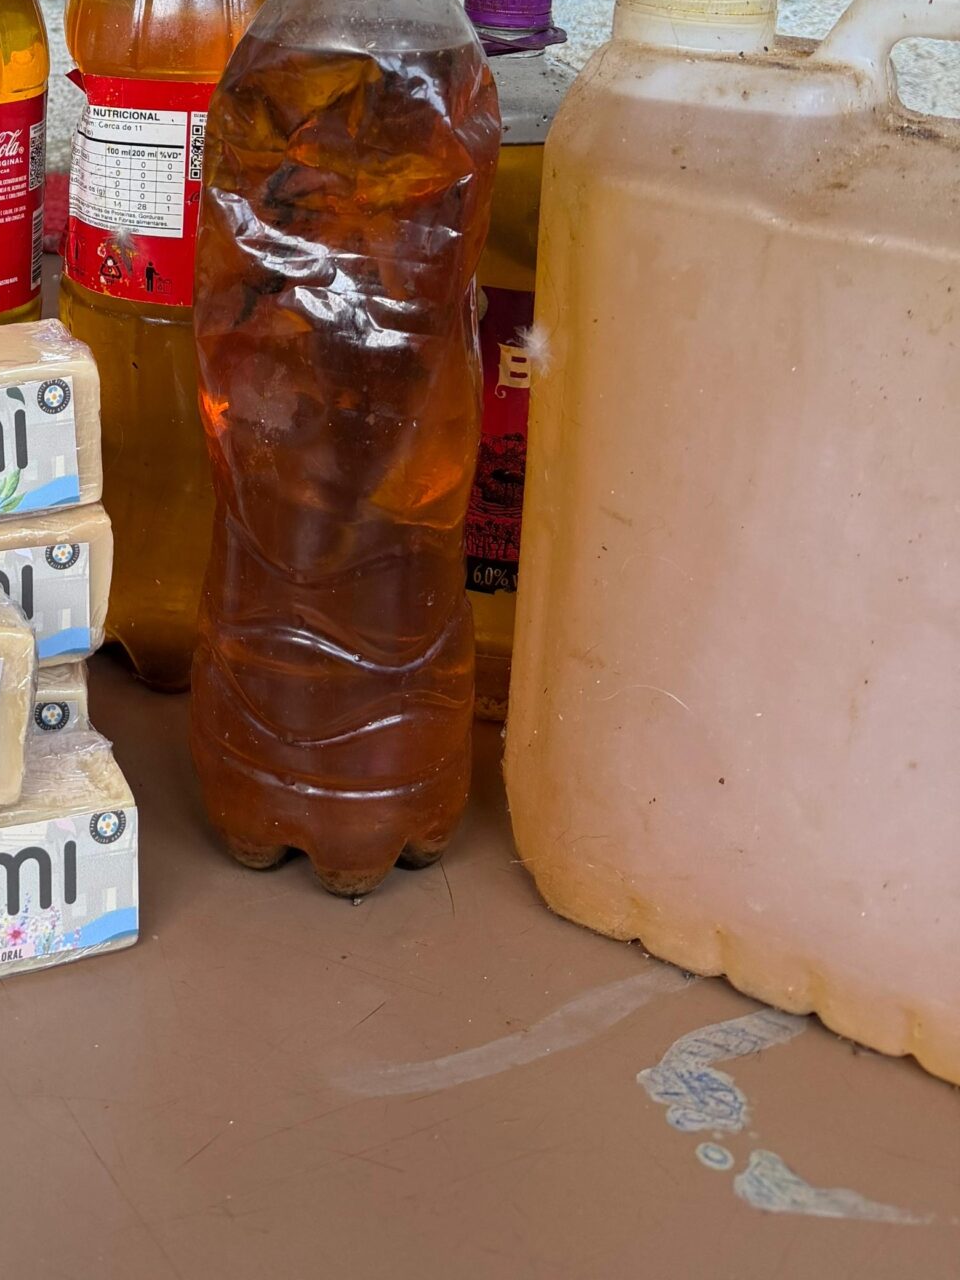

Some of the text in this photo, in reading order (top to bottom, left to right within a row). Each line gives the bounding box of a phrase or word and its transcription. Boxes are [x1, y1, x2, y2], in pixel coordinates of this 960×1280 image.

[93, 108, 160, 121] NUTRICIONAL
[107, 147, 119, 155] 100
[474, 564, 510, 588] 6,0%
